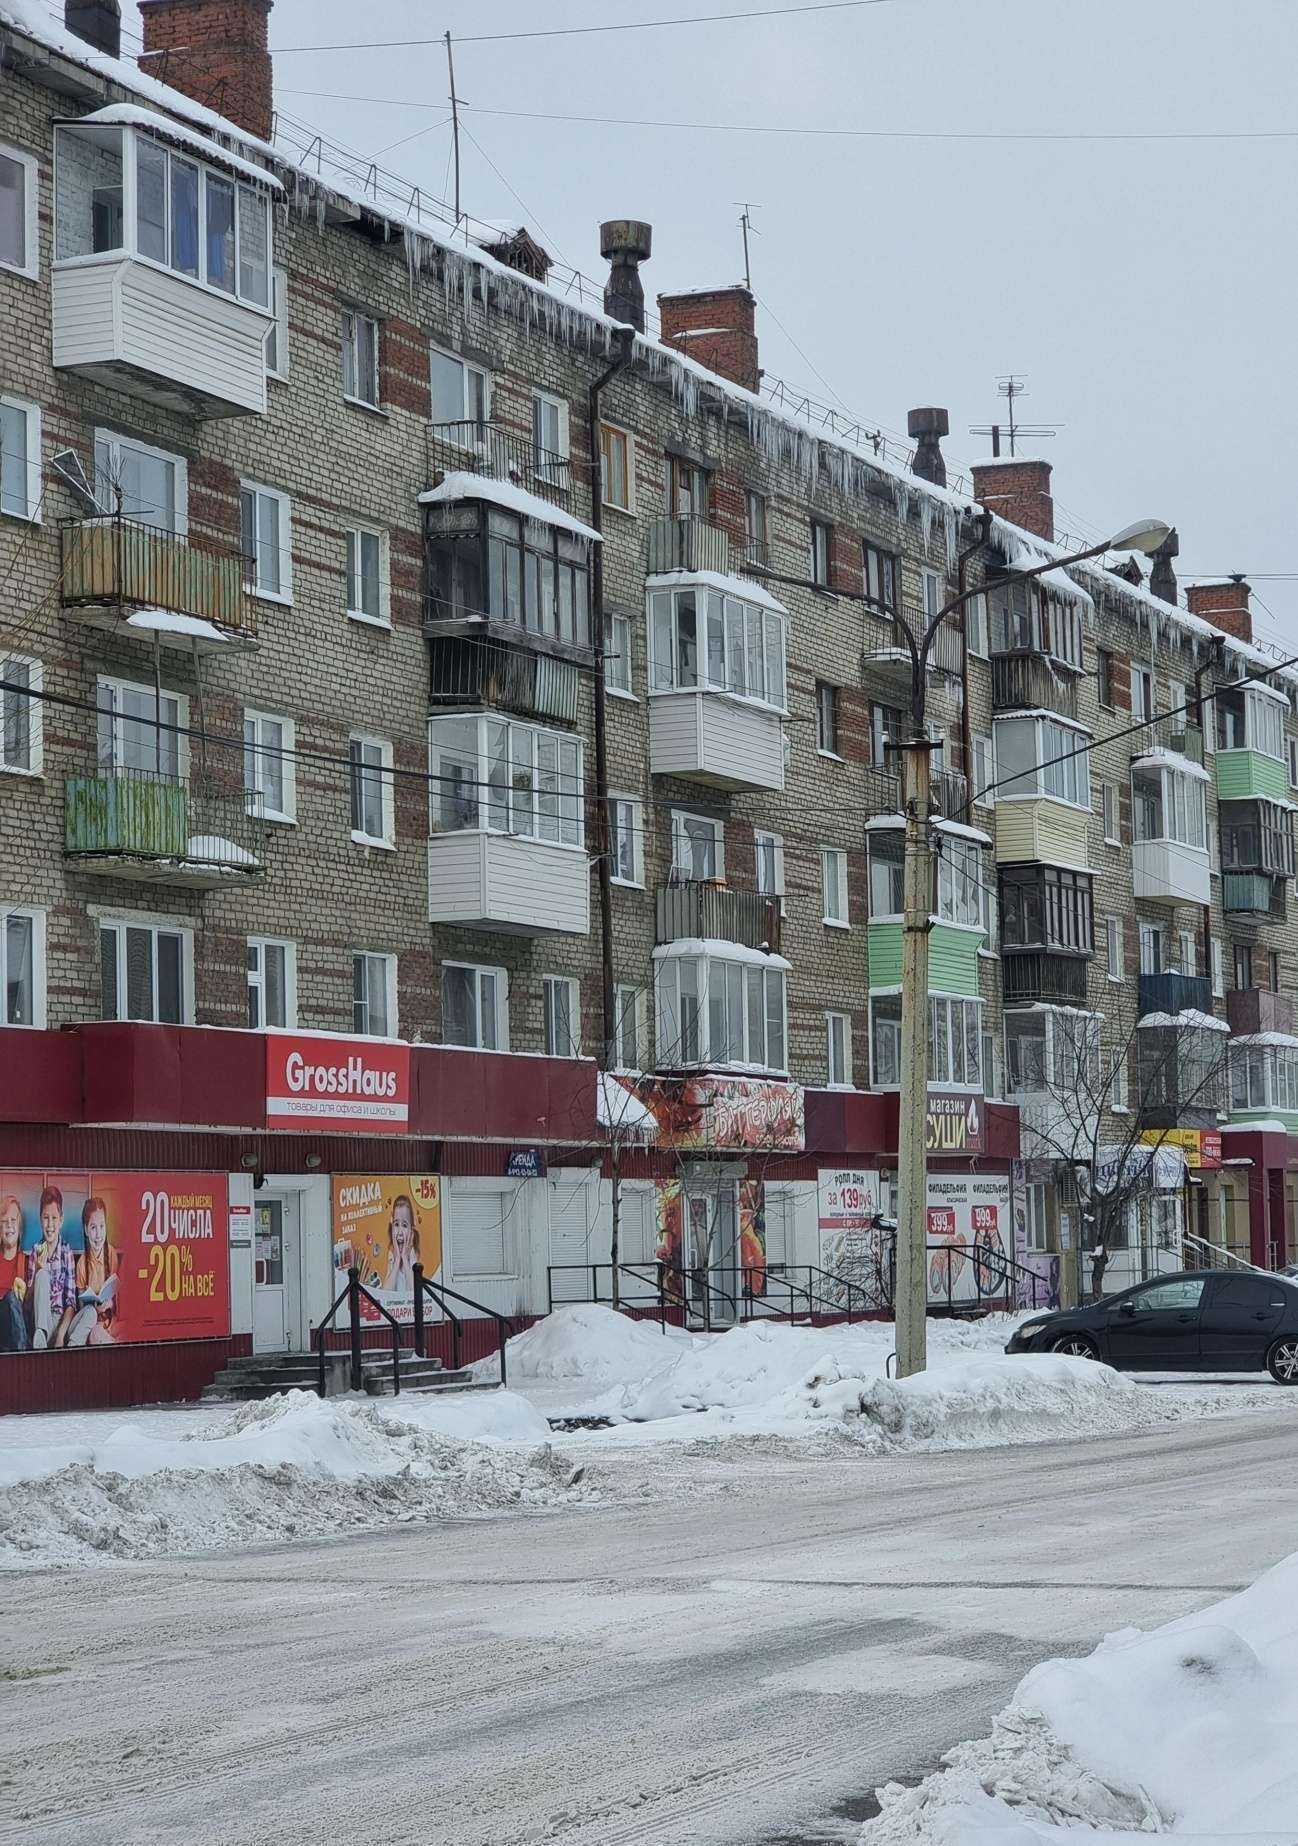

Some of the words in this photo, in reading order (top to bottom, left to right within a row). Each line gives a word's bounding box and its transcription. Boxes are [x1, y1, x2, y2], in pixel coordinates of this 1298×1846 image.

[286, 1051, 397, 1097] GrossHaus
[286, 1102, 318, 1115] товары
[320, 1103, 335, 1114] для
[336, 1104, 362, 1116] офиса
[369, 1106, 396, 1116] школы
[930, 1098, 966, 1114] магазин
[926, 1114, 966, 1149] СУШИ
[415, 1178, 436, 1199] -15%
[834, 1173, 851, 1186] РОЛЛ
[852, 1173, 865, 1185] ДНЯ
[928, 1183, 968, 1194] ФИЛАДЕЛЬФИЯ
[972, 1183, 1008, 1194] ФИЛАДЕЛЬФИЯ
[170, 1193, 195, 1209] КАЖДЫЙ
[195, 1195, 214, 1209] МЕСЯЦ
[339, 1181, 382, 1207] СКИДКА
[828, 1192, 837, 1206] за
[840, 1188, 859, 1208] 139
[141, 1191, 170, 1244] 20
[341, 1213, 347, 1222] НА
[347, 1202, 384, 1220] КОЛЛЕКТИВНЫЙ
[975, 1208, 991, 1228] 999
[170, 1209, 214, 1239] ЧИСЛА
[342, 1223, 357, 1234] ЗАКАЗ
[931, 1213, 947, 1232] 399
[182, 1275, 195, 1297] НА
[197, 1270, 215, 1297] ВСЁ
